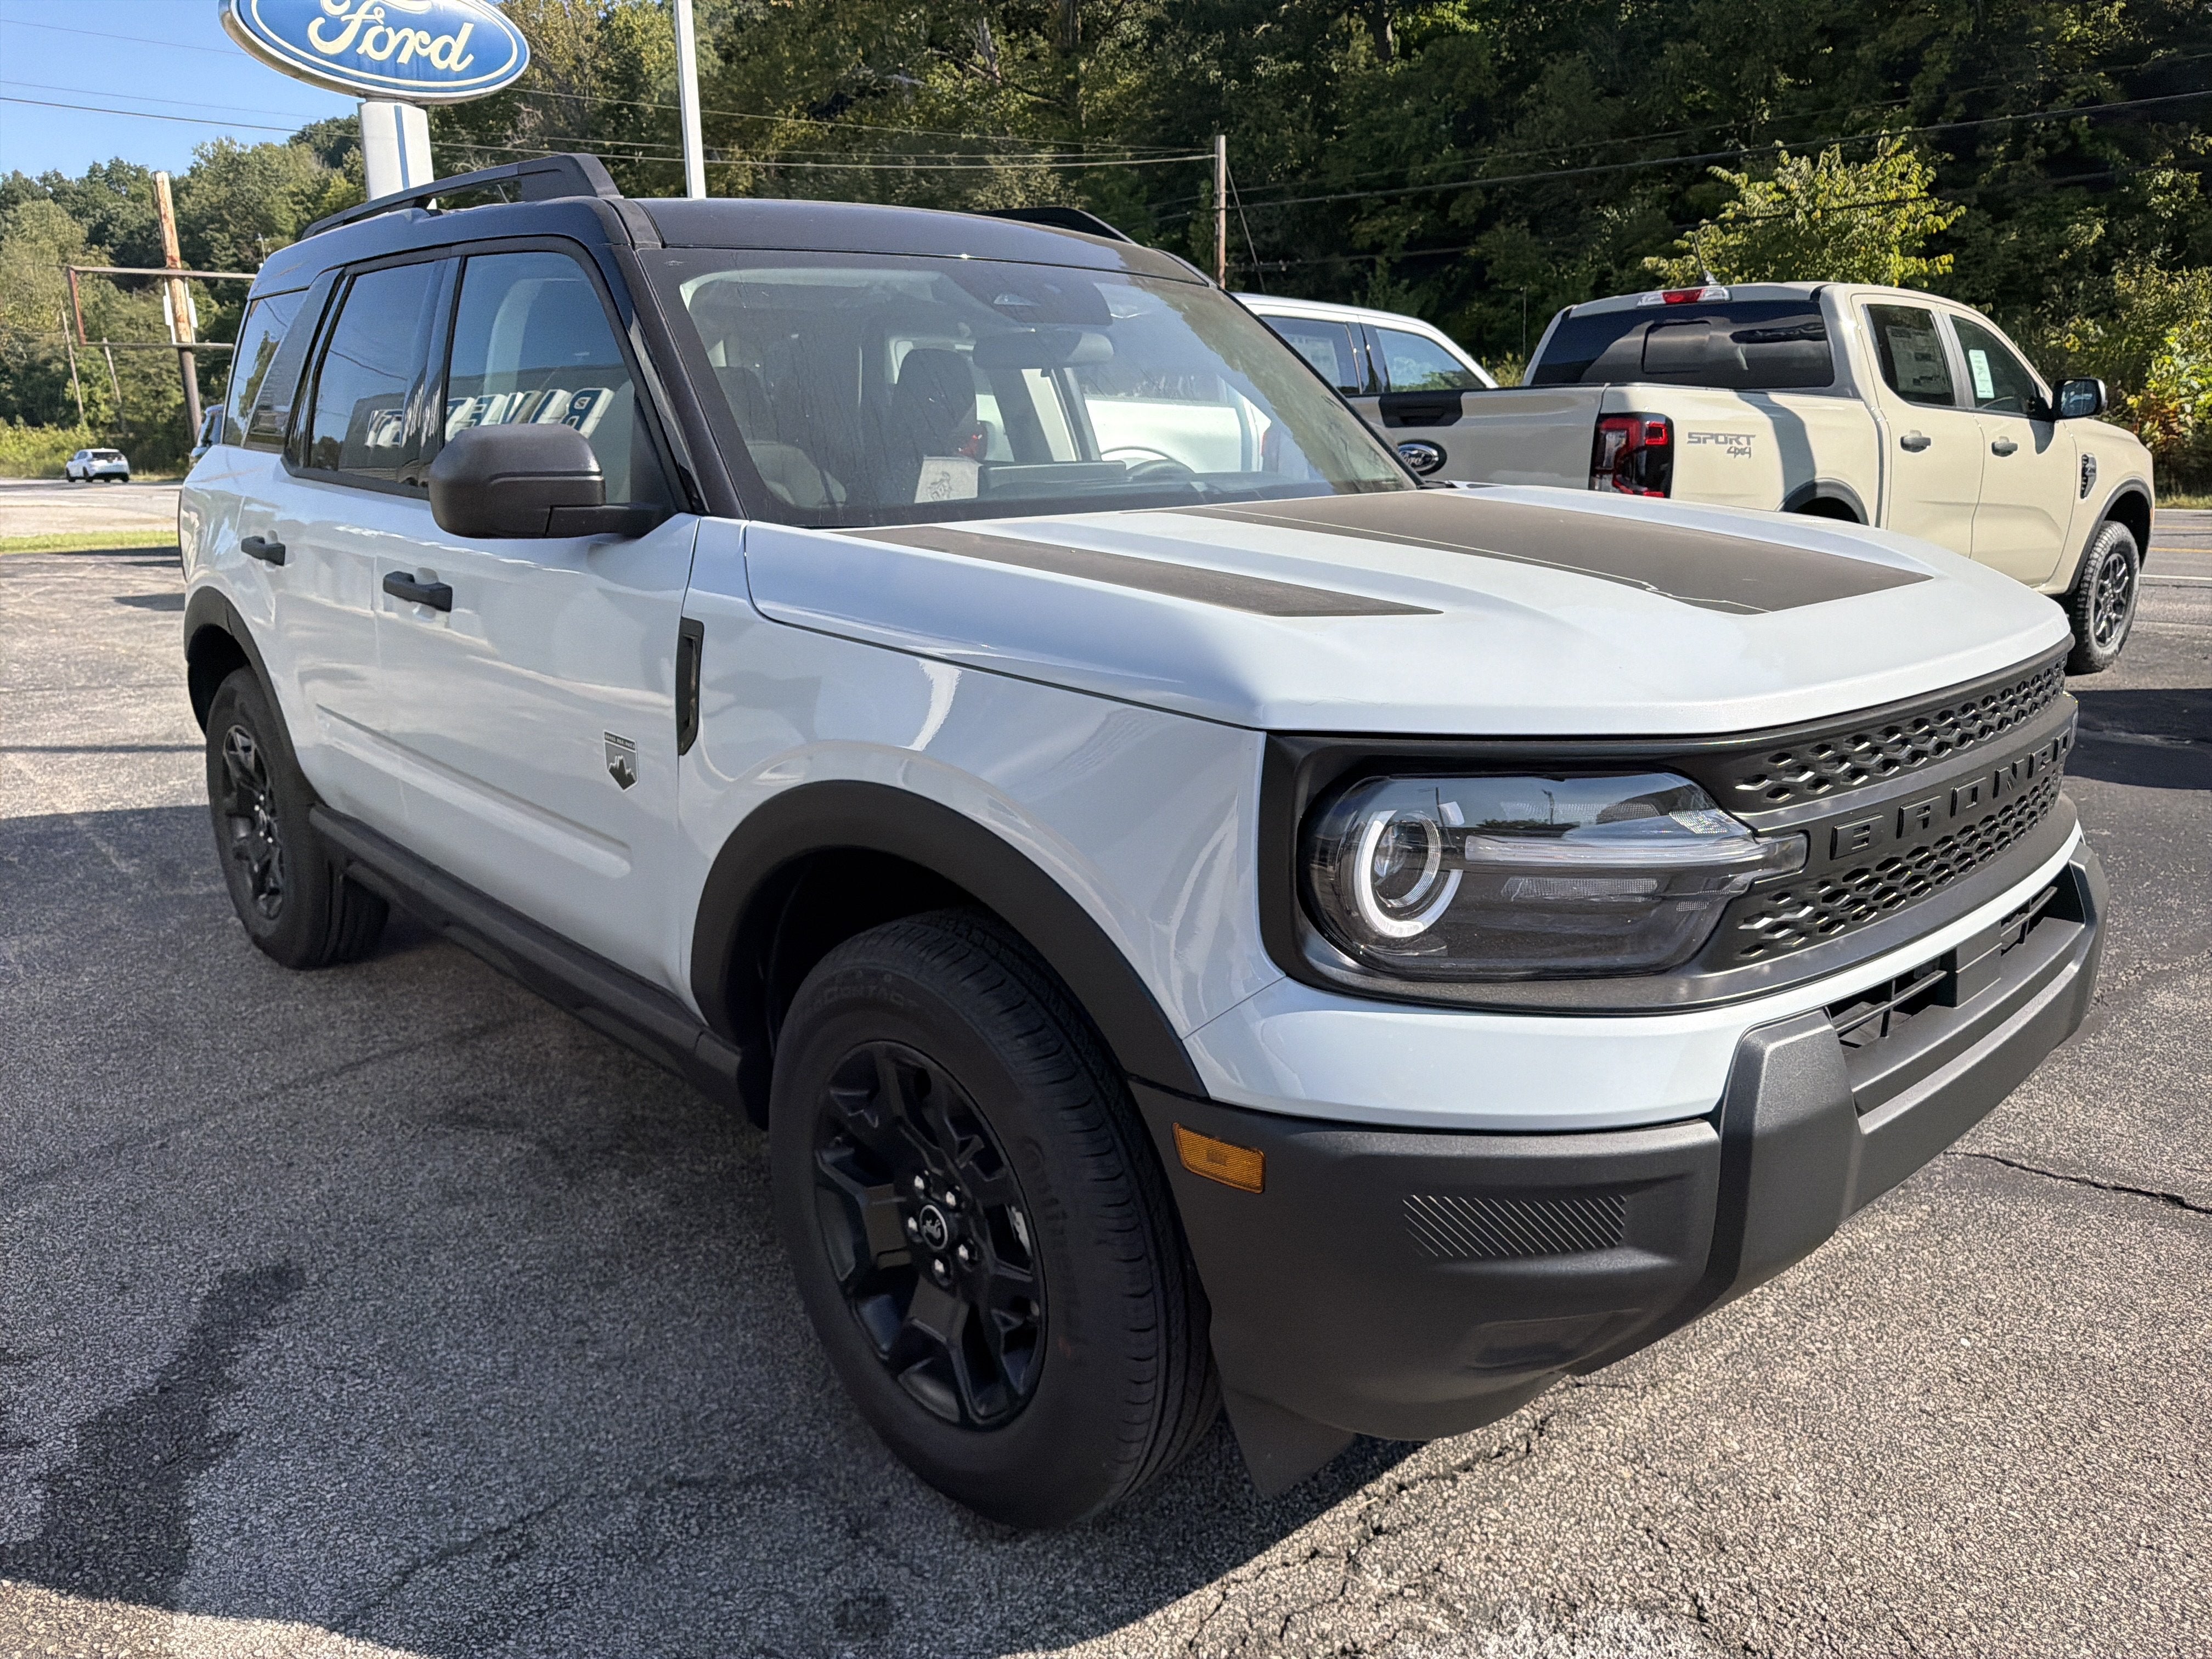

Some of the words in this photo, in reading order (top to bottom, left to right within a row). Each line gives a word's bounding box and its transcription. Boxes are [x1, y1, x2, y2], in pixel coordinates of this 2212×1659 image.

[307, 0, 475, 71] Ford
[1687, 432, 1756, 445] SPORT
[1726, 446, 1752, 459] 4x4
[1829, 727, 2071, 861] BRONCO
